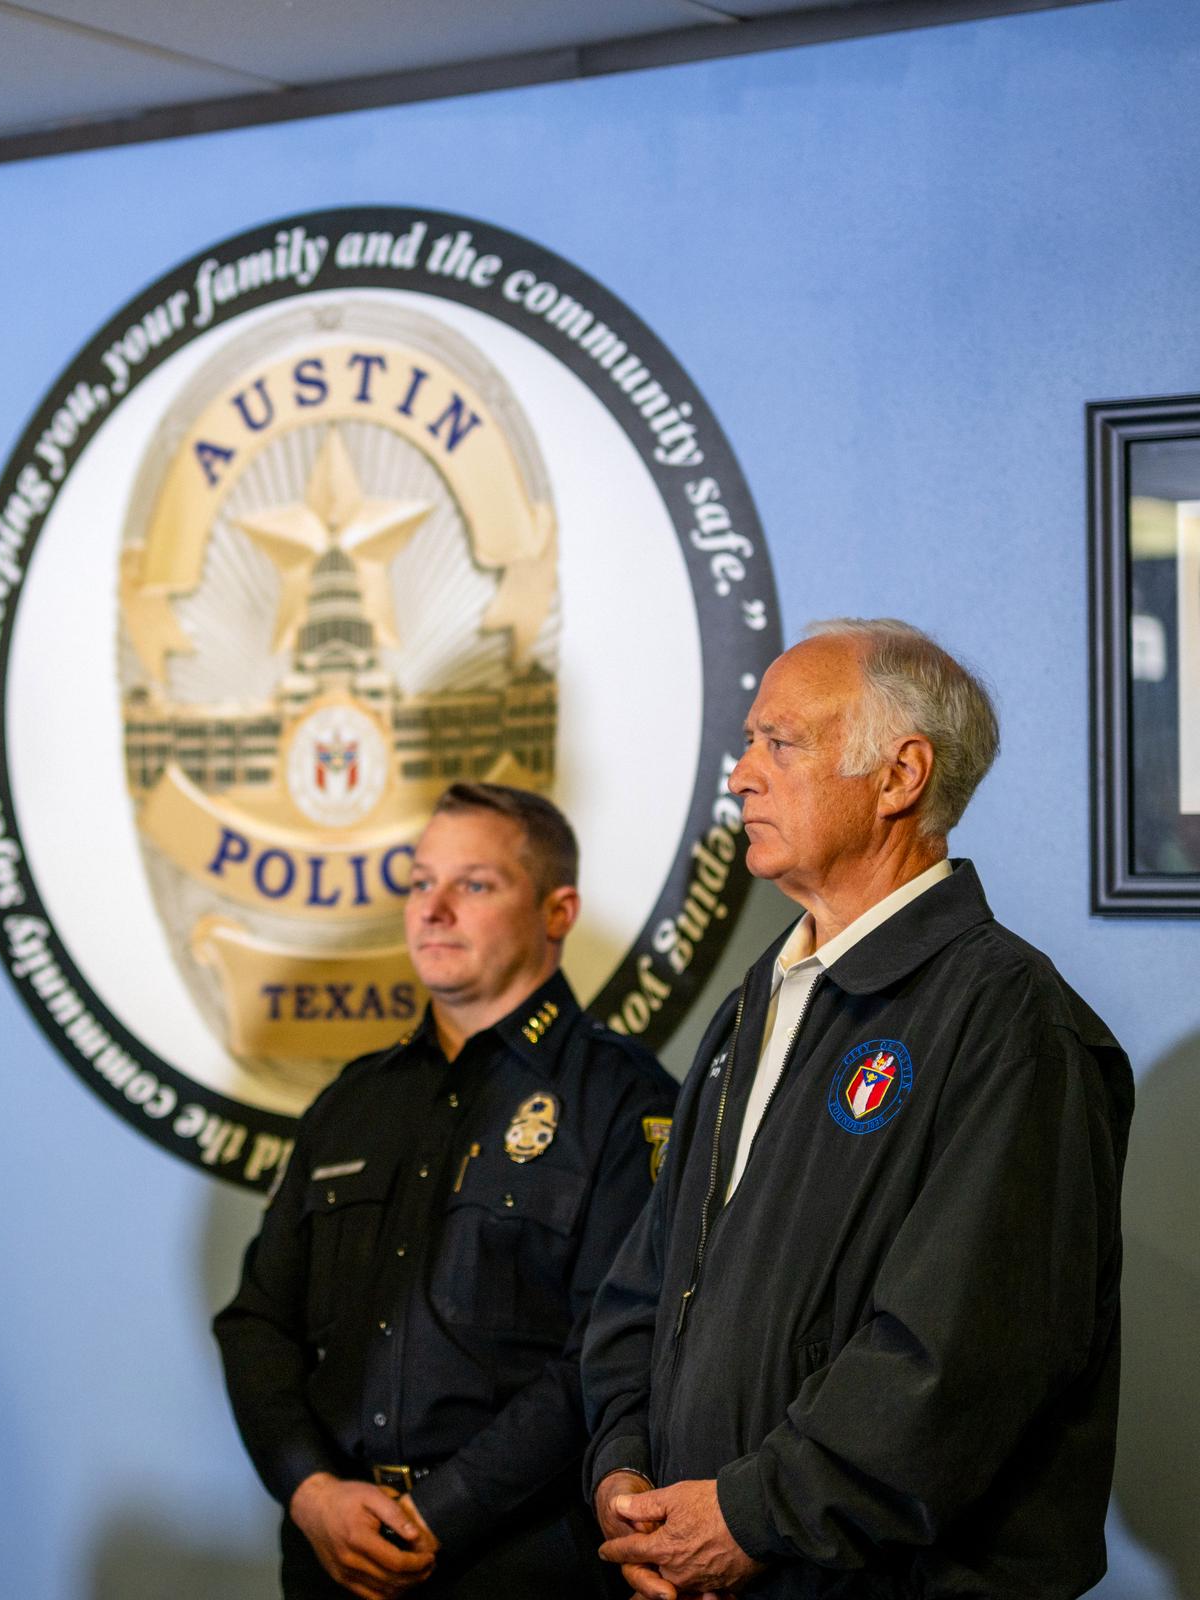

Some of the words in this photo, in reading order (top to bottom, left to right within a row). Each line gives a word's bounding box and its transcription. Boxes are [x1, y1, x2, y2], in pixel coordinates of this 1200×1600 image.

[34, 381, 110, 479] you,
[102, 290, 189, 391] your
[194, 226, 329, 327] family
[335, 222, 428, 270] and
[425, 229, 503, 288] the
[503, 269, 705, 467] community
[193, 352, 482, 486] AUSTIN
[207, 825, 416, 908] POLIC
[4, 915, 177, 1117] community
[263, 980, 417, 1021] TEXAS
[173, 1104, 248, 1164] the
